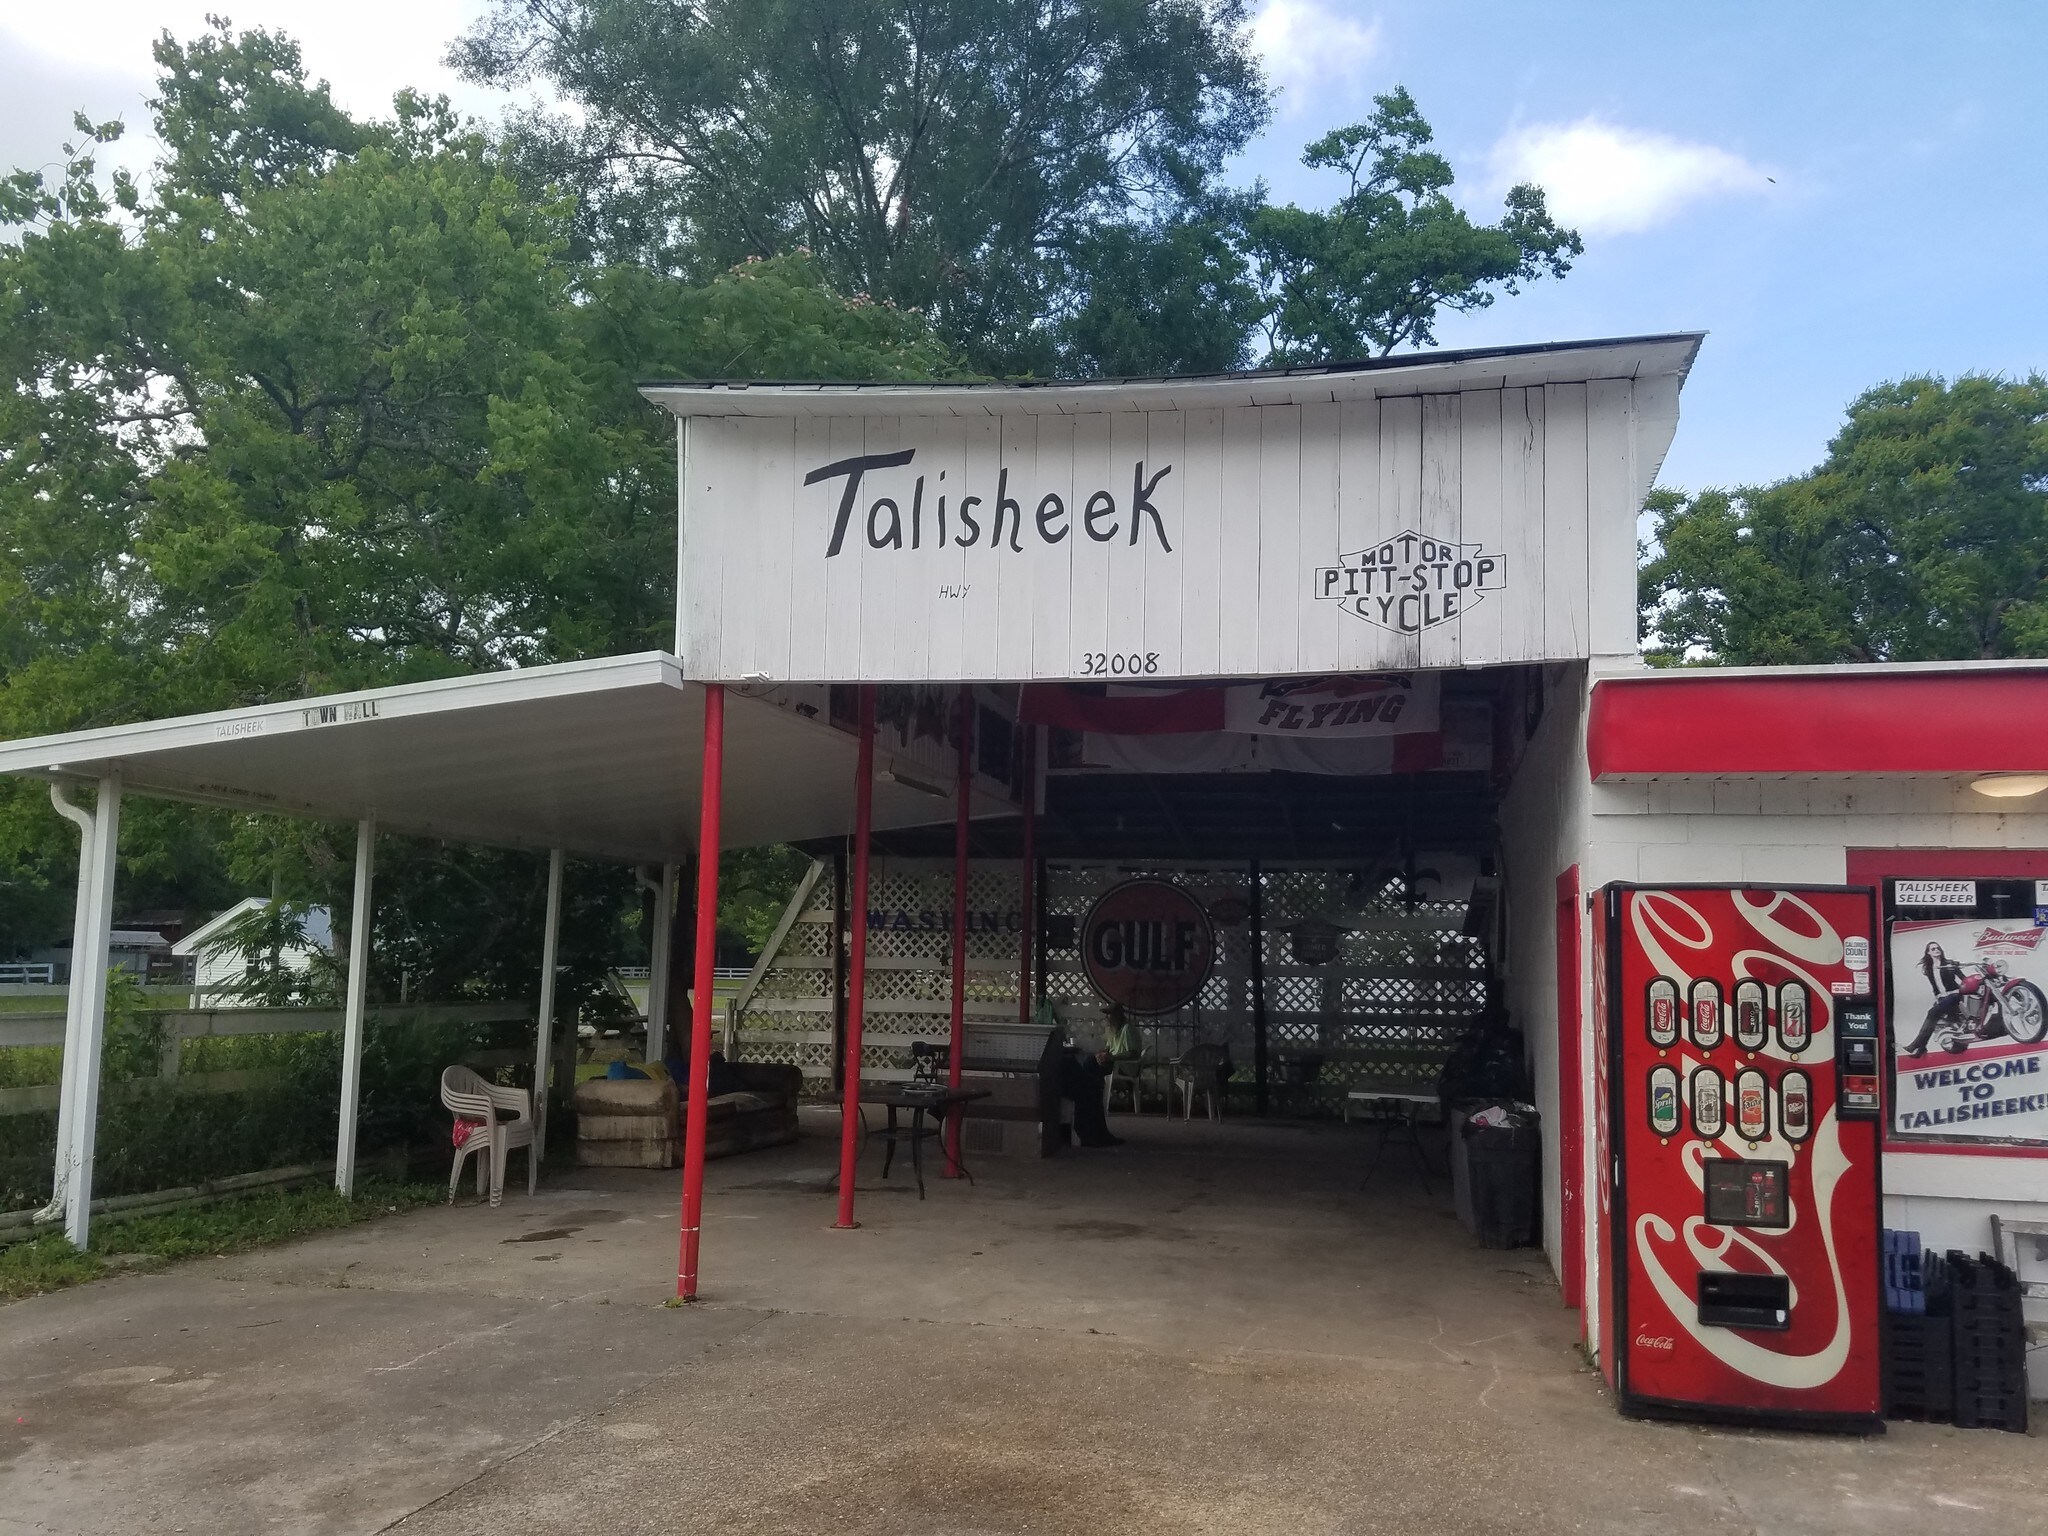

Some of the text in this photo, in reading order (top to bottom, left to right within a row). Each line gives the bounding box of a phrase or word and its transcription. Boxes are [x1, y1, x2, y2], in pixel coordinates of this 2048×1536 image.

[1361, 534, 1453, 567] MOTOR
[1324, 558, 1495, 597] PITT-STOP
[938, 583, 971, 600] HWY
[1355, 592, 1458, 632] CYCLE
[1079, 652, 1160, 676] 32008
[1258, 694, 1406, 730] FLYING
[215, 720, 264, 737] TALISHEEK
[1899, 883, 1970, 892] TALISHEEK
[1899, 894, 1974, 903] SELLS BEER
[1093, 920, 1196, 971] GULF
[1844, 1012, 1872, 1021] Thank
[1847, 1022, 1868, 1030] You!
[1914, 1056, 2041, 1091] WELCOME
[1958, 1083, 1995, 1103] TO
[1899, 1093, 2048, 1130] TALISHEEK!
